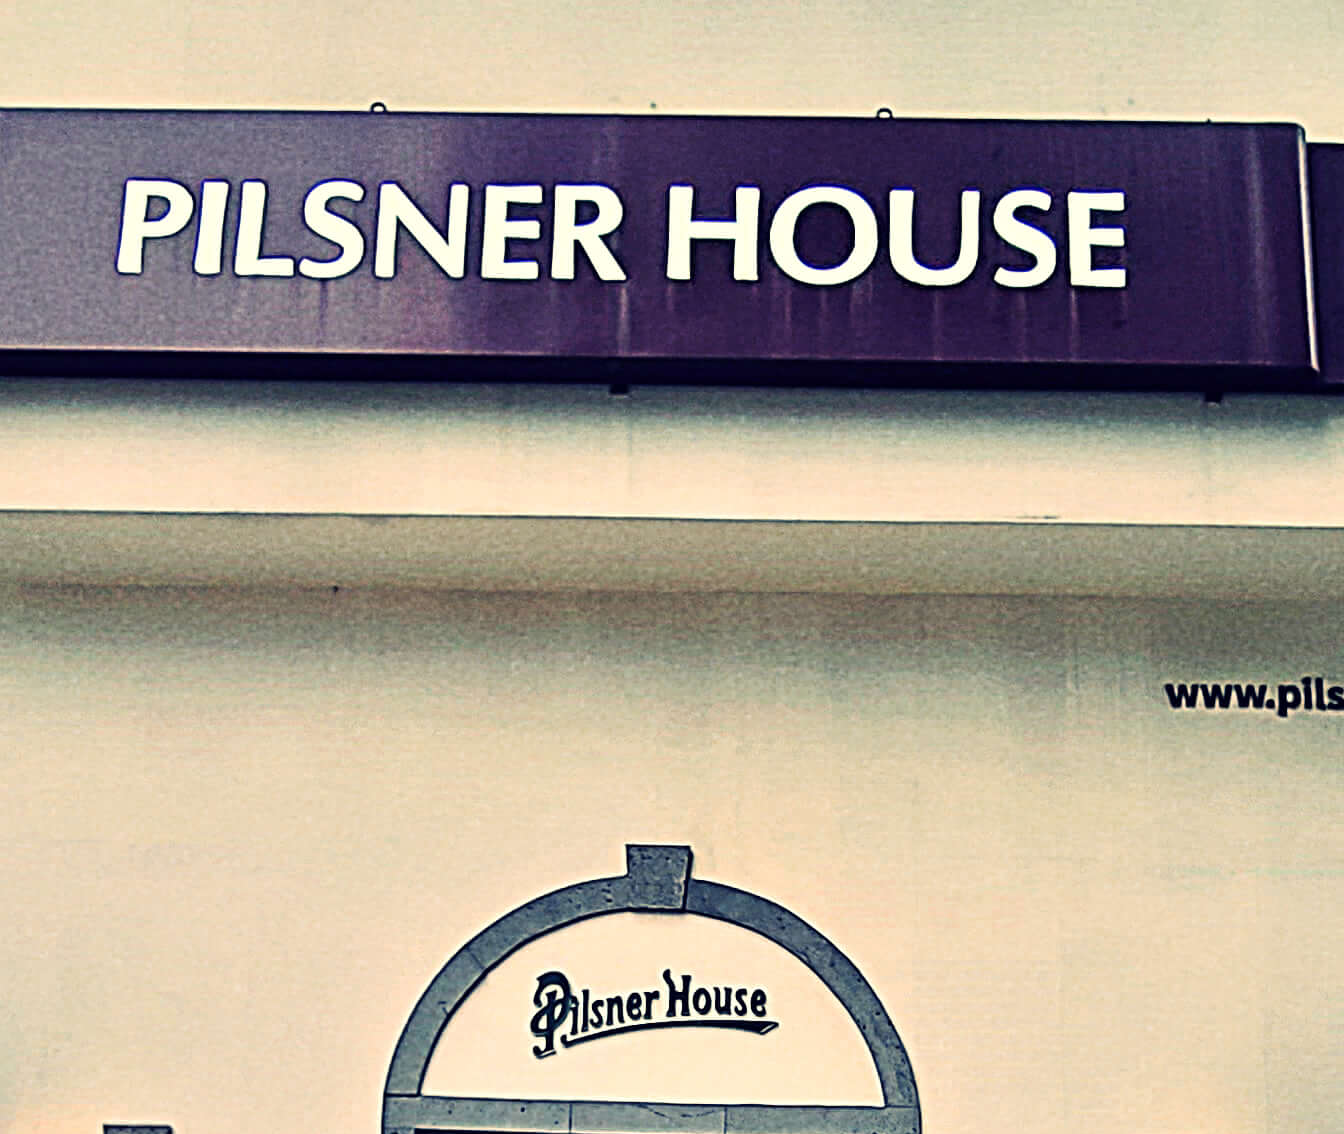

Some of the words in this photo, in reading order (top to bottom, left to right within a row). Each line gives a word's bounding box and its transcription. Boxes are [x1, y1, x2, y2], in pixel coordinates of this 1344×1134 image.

[115, 180, 626, 281] PILSNER
[666, 185, 1126, 288] HOUSE
[530, 971, 660, 1059] Pilsner
[663, 969, 767, 1018] House
